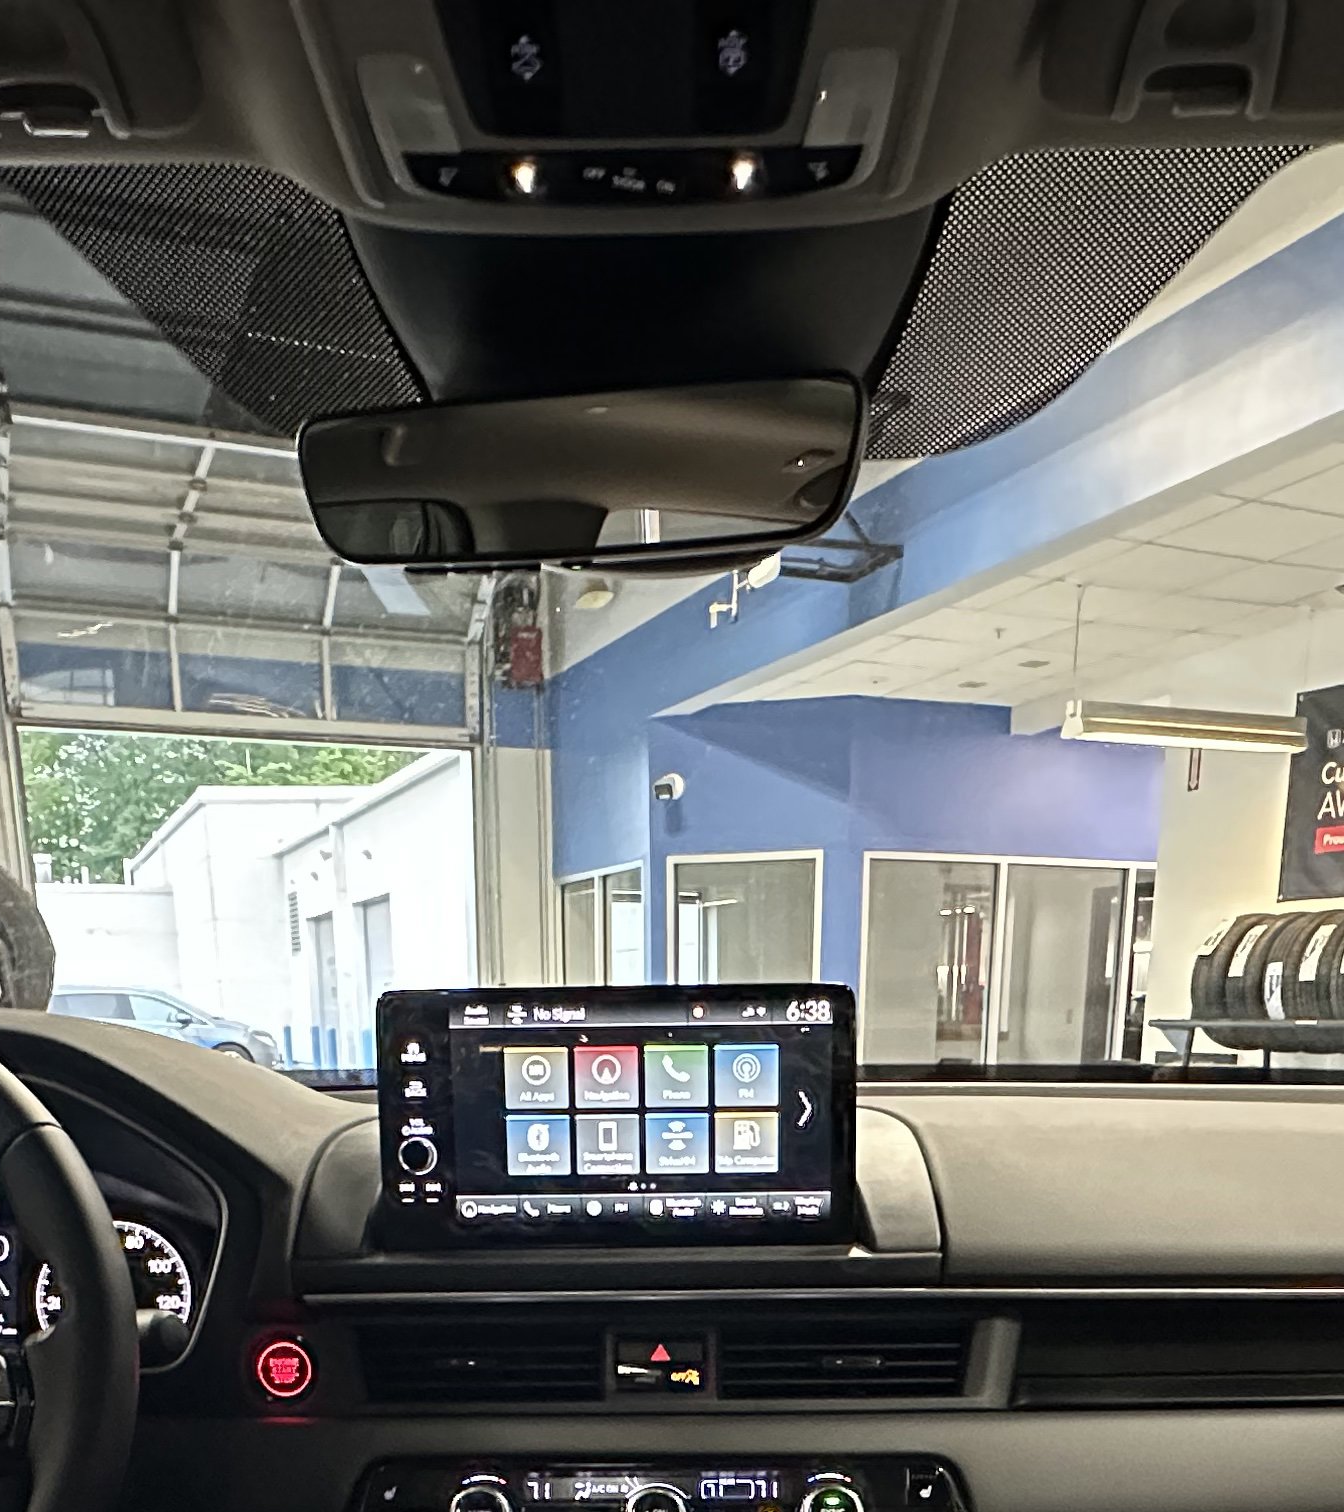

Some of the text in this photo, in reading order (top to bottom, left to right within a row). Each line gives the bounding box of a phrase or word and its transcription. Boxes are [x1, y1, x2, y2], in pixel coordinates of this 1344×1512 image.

[532, 1006, 586, 1023] No Signal
[785, 1000, 832, 1022] 6:38
[147, 1258, 173, 1274] 100
[156, 1294, 182, 1310] 120
